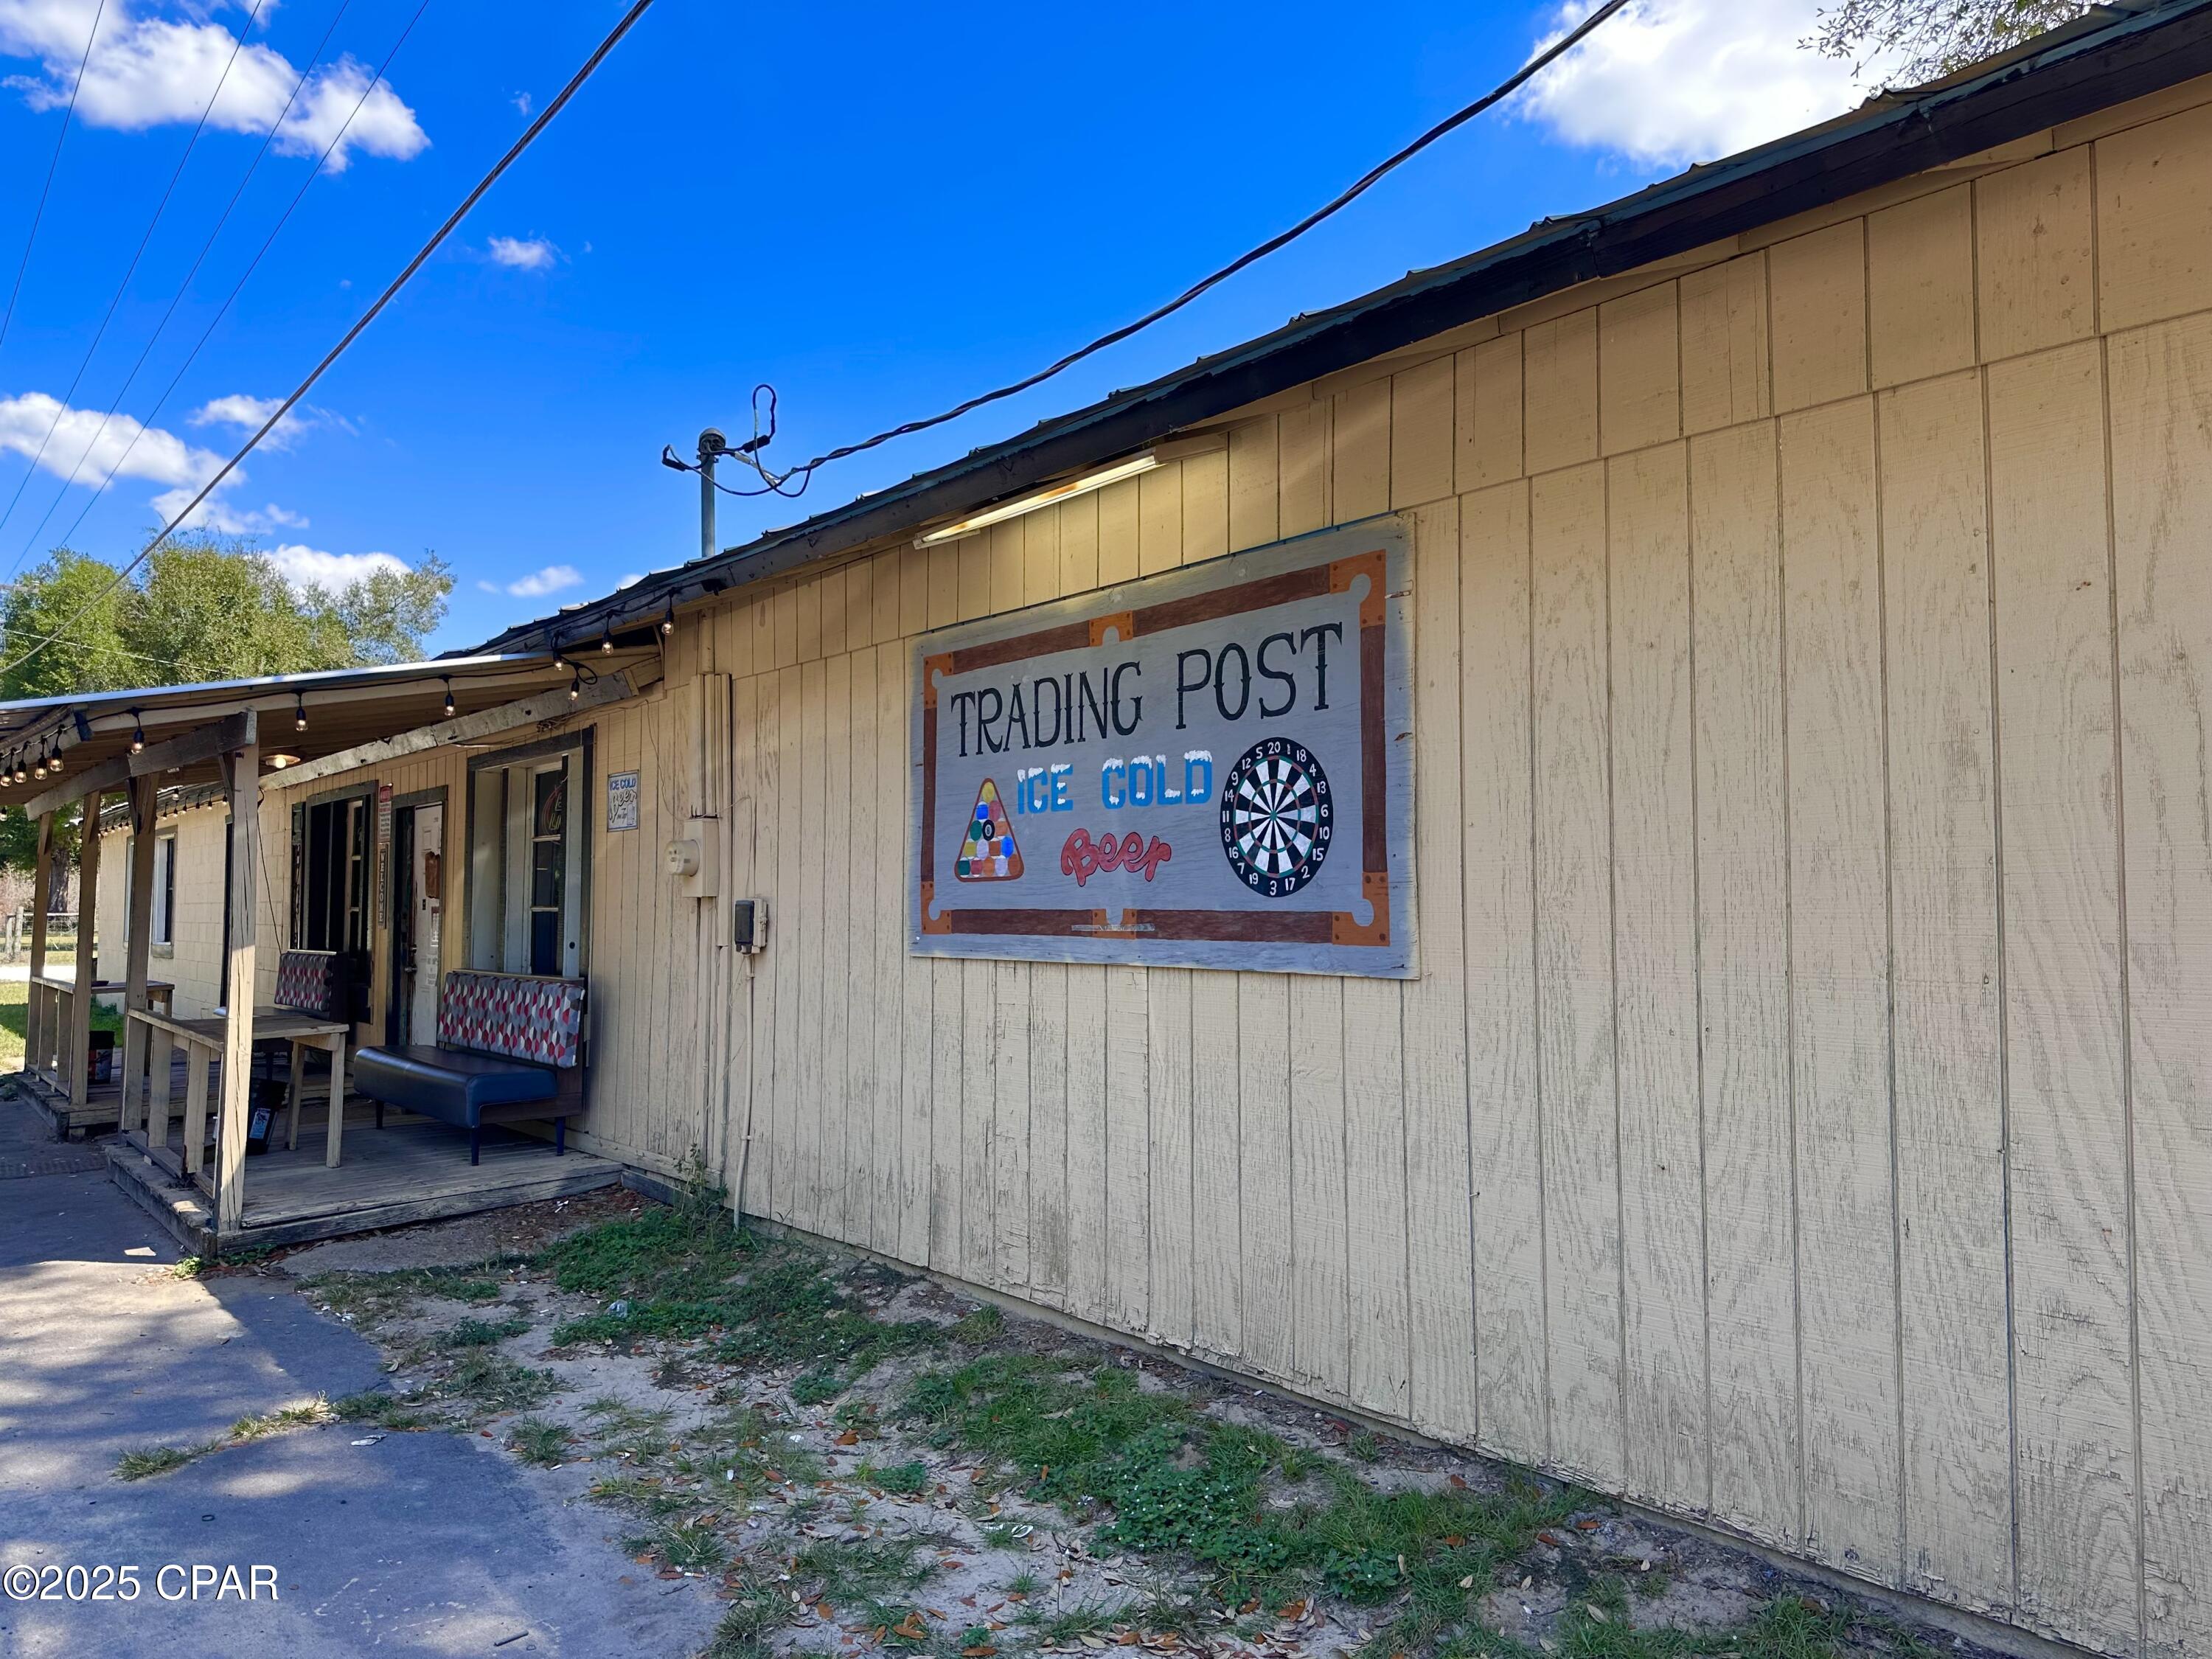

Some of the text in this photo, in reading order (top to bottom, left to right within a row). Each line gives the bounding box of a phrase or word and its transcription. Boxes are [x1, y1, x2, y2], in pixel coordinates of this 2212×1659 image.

[951, 622, 1343, 757] TRADING POST
[1256, 746, 1263, 759] 5
[1267, 741, 1281, 754] 20
[1287, 744, 1291, 754] 1
[1296, 748, 1307, 762] 18
[1242, 758, 1251, 770] 12
[1310, 764, 1317, 776] 4
[610, 778, 636, 790] ICE COLD
[1018, 750, 1212, 814] ICE COLD
[1231, 771, 1239, 786] 9
[1317, 781, 1326, 794] 13
[1225, 789, 1234, 802] 14
[610, 789, 638, 824] Beer
[1321, 804, 1329, 817] 6
[1222, 810, 1230, 823] 11
[1225, 828, 1231, 842] 8
[1319, 827, 1330, 840] 10
[1061, 828, 1172, 887] Beer
[1229, 846, 1239, 859] 16
[1312, 848, 1324, 861] 15
[1237, 863, 1245, 874] 7
[1301, 866, 1310, 879] 2
[1249, 873, 1259, 885] 19
[1285, 877, 1295, 891] 17
[1269, 880, 1277, 896] 3
